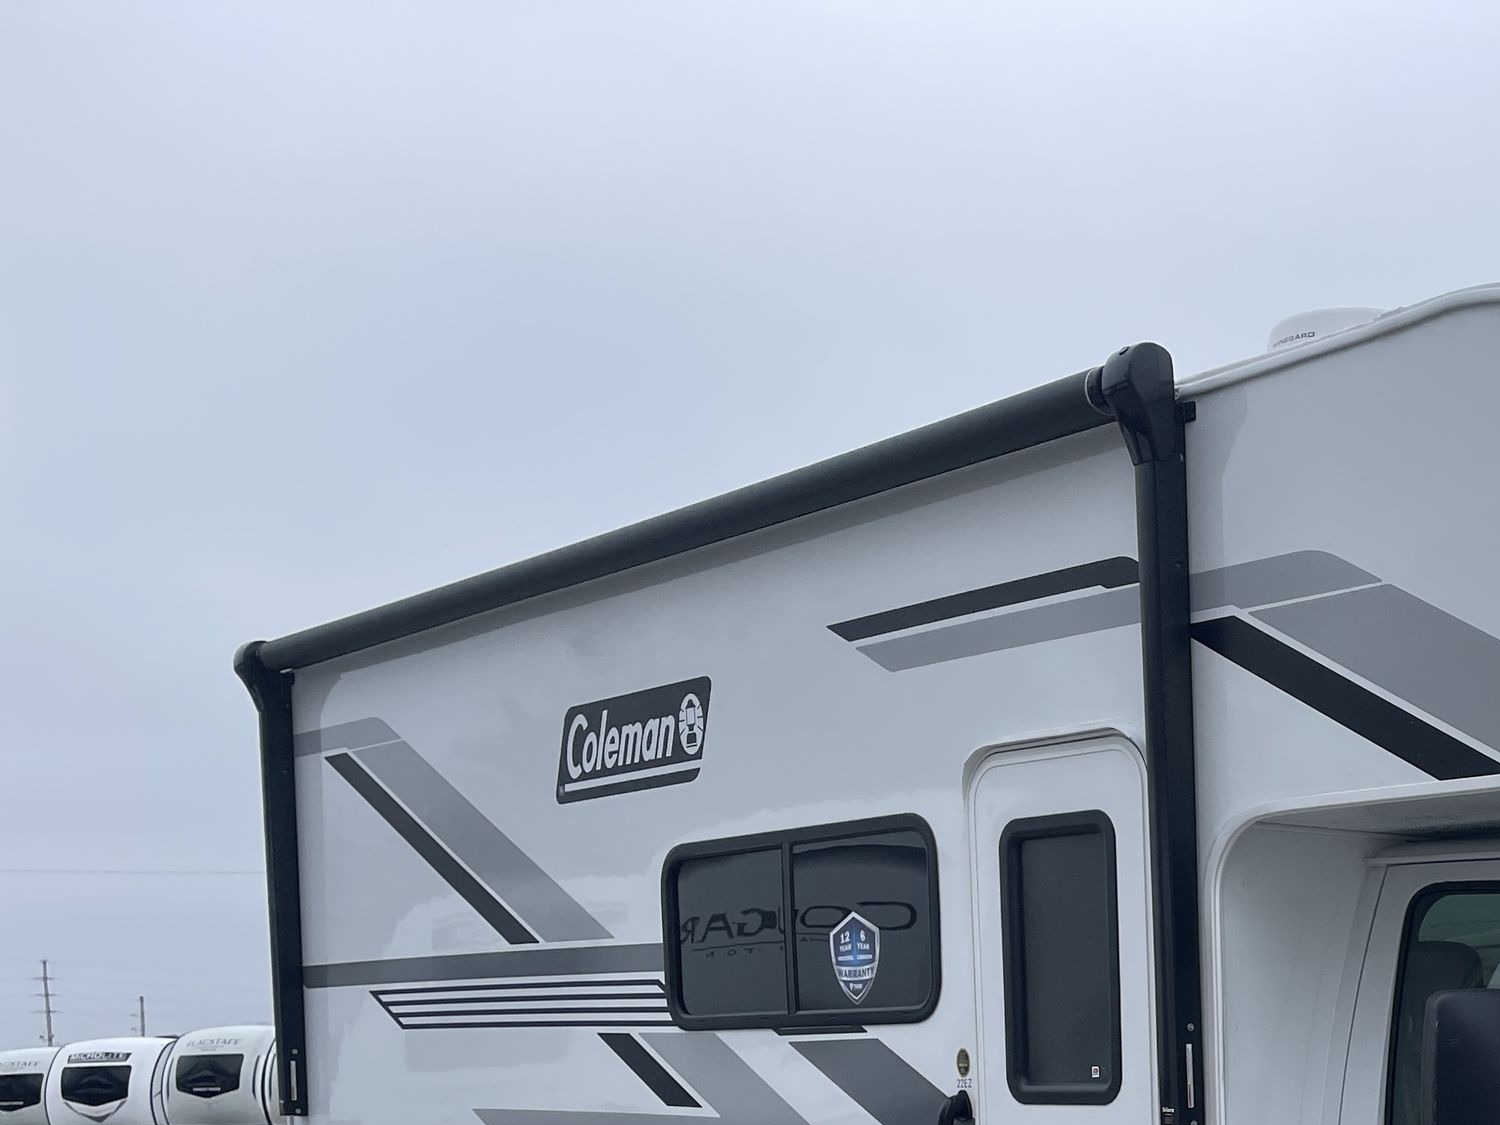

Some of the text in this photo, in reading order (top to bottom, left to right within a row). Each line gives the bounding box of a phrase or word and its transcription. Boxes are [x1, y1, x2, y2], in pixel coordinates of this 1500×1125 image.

[566, 709, 676, 780] Coleman
[840, 929, 866, 944] 12 6
[837, 967, 874, 979] WARRANTY
